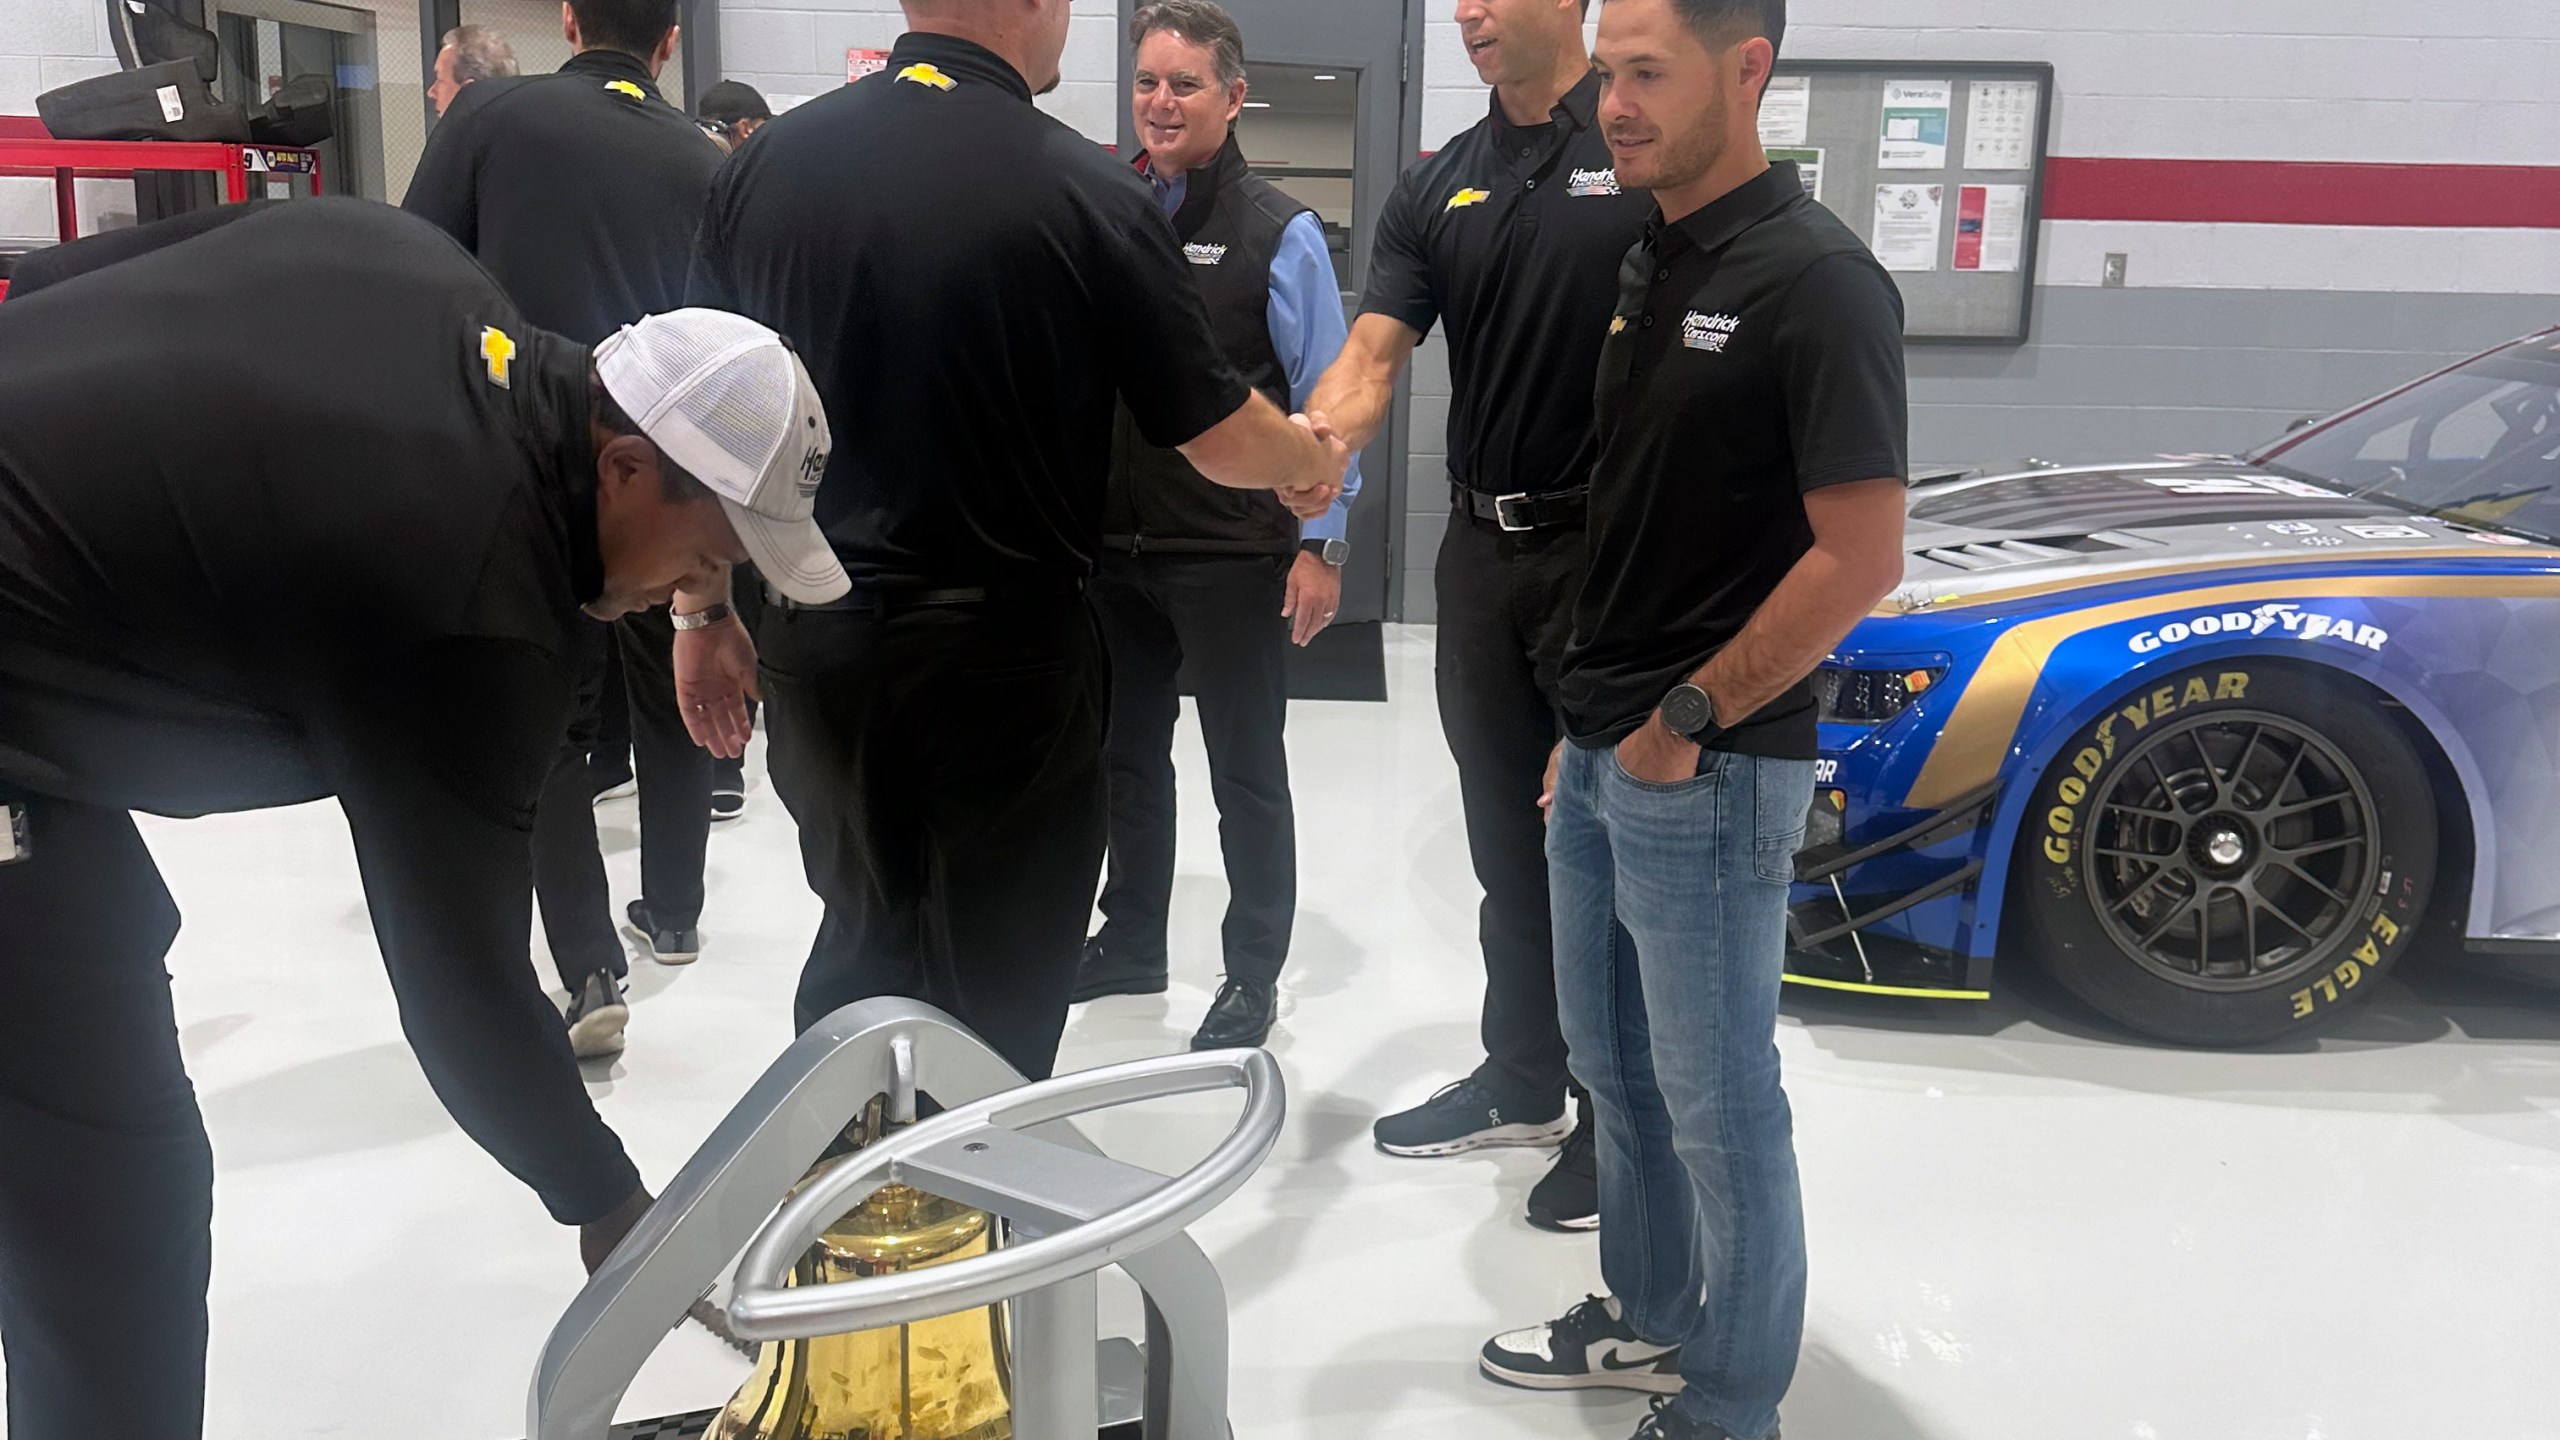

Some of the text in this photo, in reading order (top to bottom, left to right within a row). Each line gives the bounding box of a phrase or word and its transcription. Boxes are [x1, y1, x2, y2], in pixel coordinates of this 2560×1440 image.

[1182, 242, 1228, 255] Hendrick
[1681, 310, 1740, 333] Hendrick
[2128, 603, 2388, 654] GOODYEAR
[2044, 671, 2250, 864] GOODYEAR
[2290, 912, 2400, 1020] EAGLE
